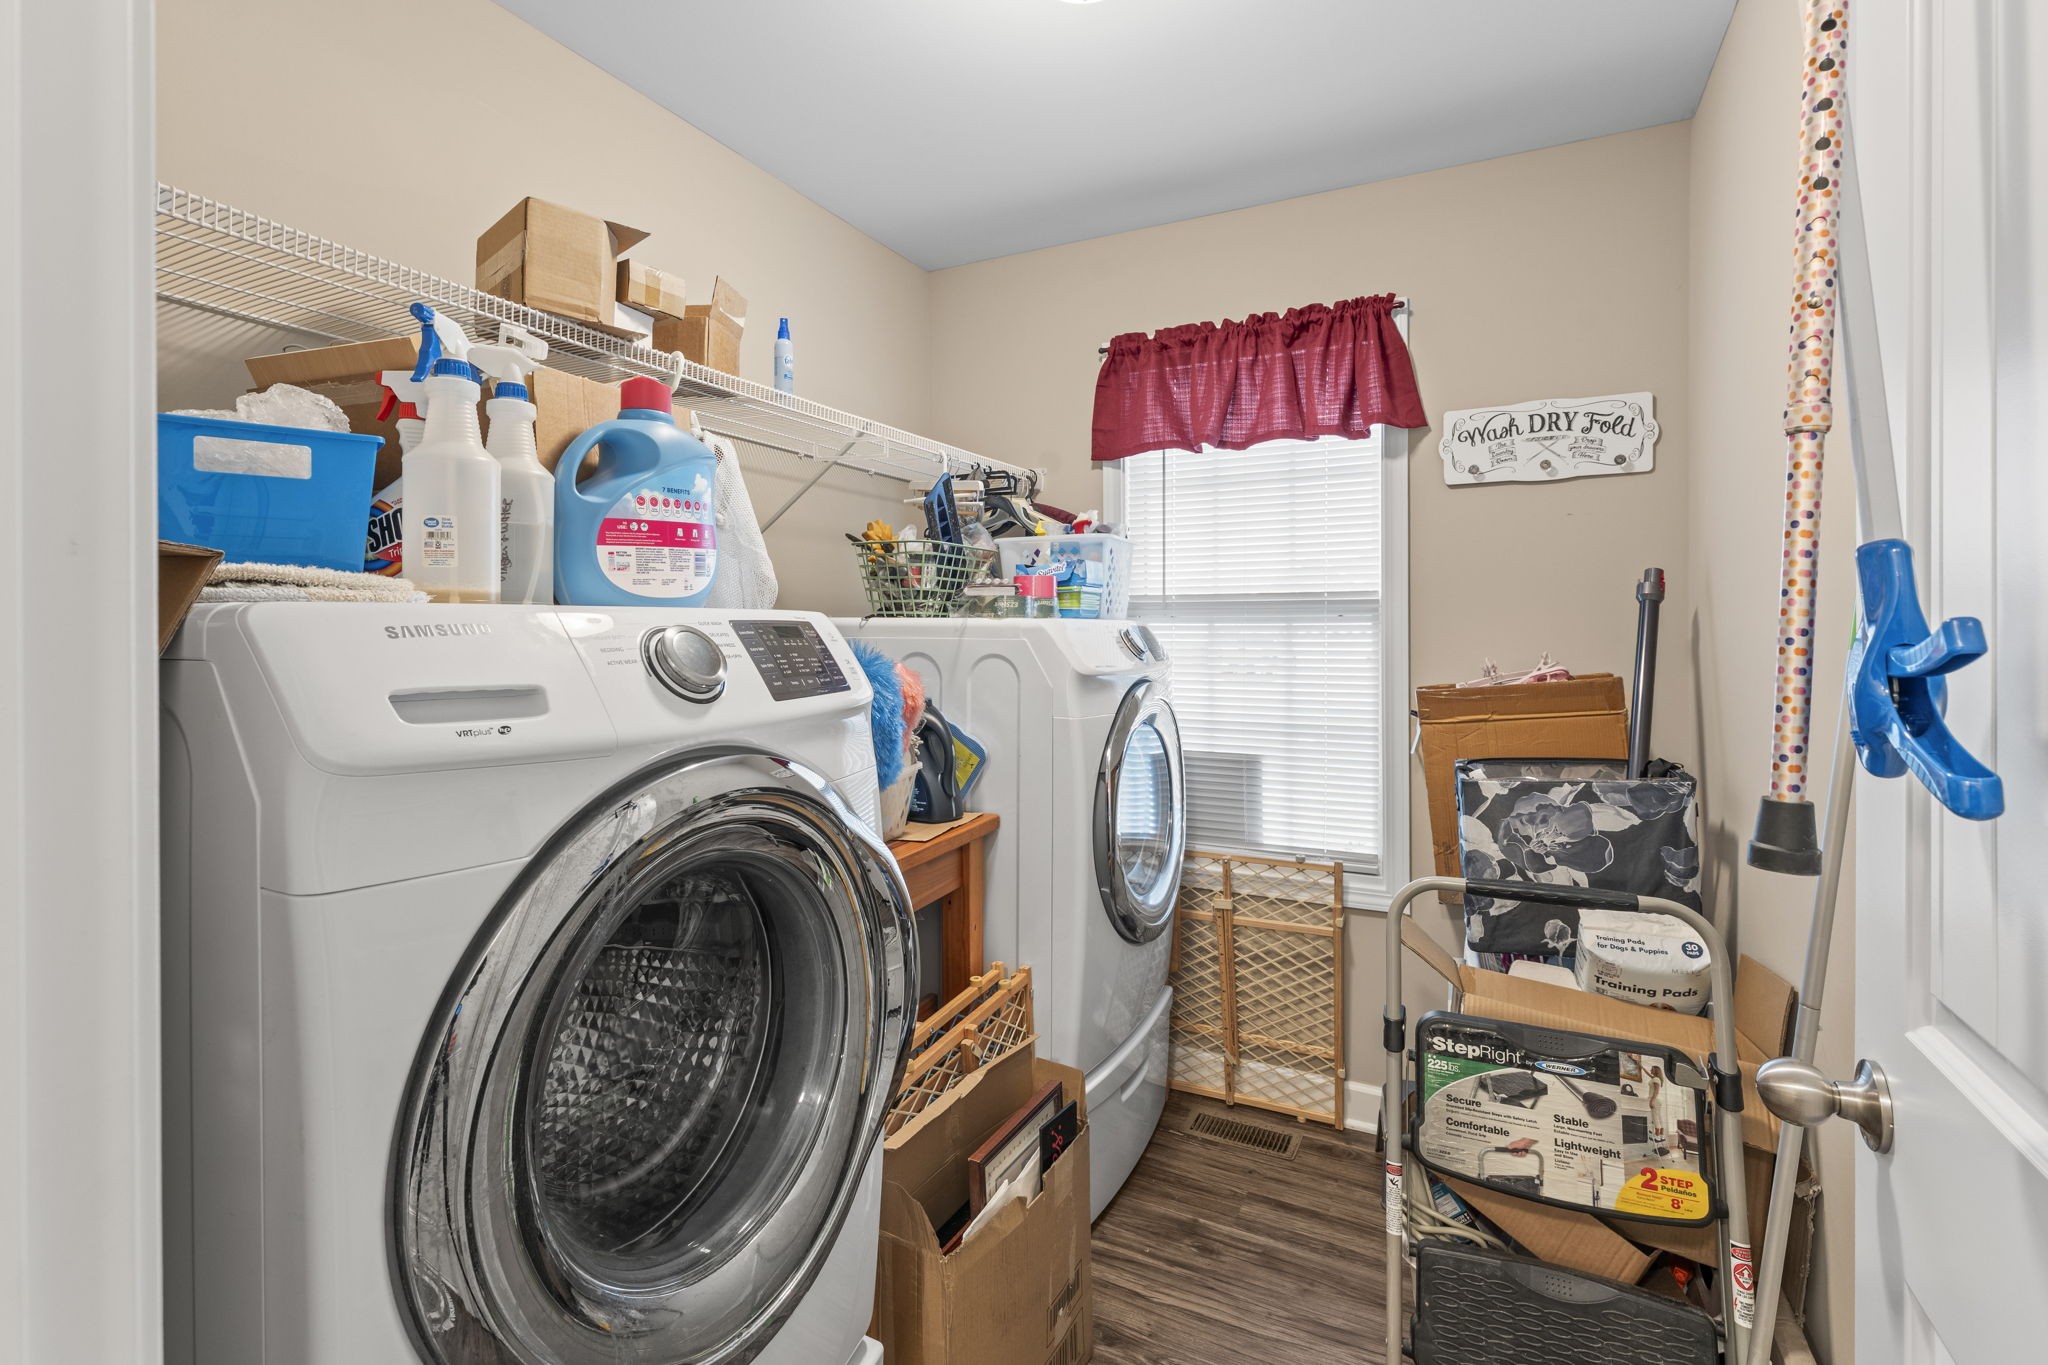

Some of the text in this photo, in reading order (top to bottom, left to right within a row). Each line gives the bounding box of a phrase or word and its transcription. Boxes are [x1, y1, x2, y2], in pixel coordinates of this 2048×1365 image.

[1458, 411, 1636, 447] Wash DRY Fold
[368, 508, 403, 553] SHO
[389, 547, 402, 558] Tri
[384, 623, 492, 639] SAMSUNG
[1596, 935, 1645, 946] Training Pads
[1686, 944, 1698, 952] 30
[1610, 944, 1628, 952] Dogs
[1639, 947, 1669, 956] Puppies
[1594, 975, 1657, 998] Training
[1662, 988, 1699, 998] Pads
[1545, 1063, 1576, 1073] WERNER
[1446, 1093, 1482, 1108] Secure
[1446, 1117, 1510, 1137] Comfortable
[1553, 1114, 1589, 1129] Stable
[1554, 1138, 1622, 1160] Lightweight
[1640, 1167, 1694, 1191] 2 STEP
[1660, 1185, 1697, 1198] Peldaños
[1671, 1198, 1684, 1210] 8'
